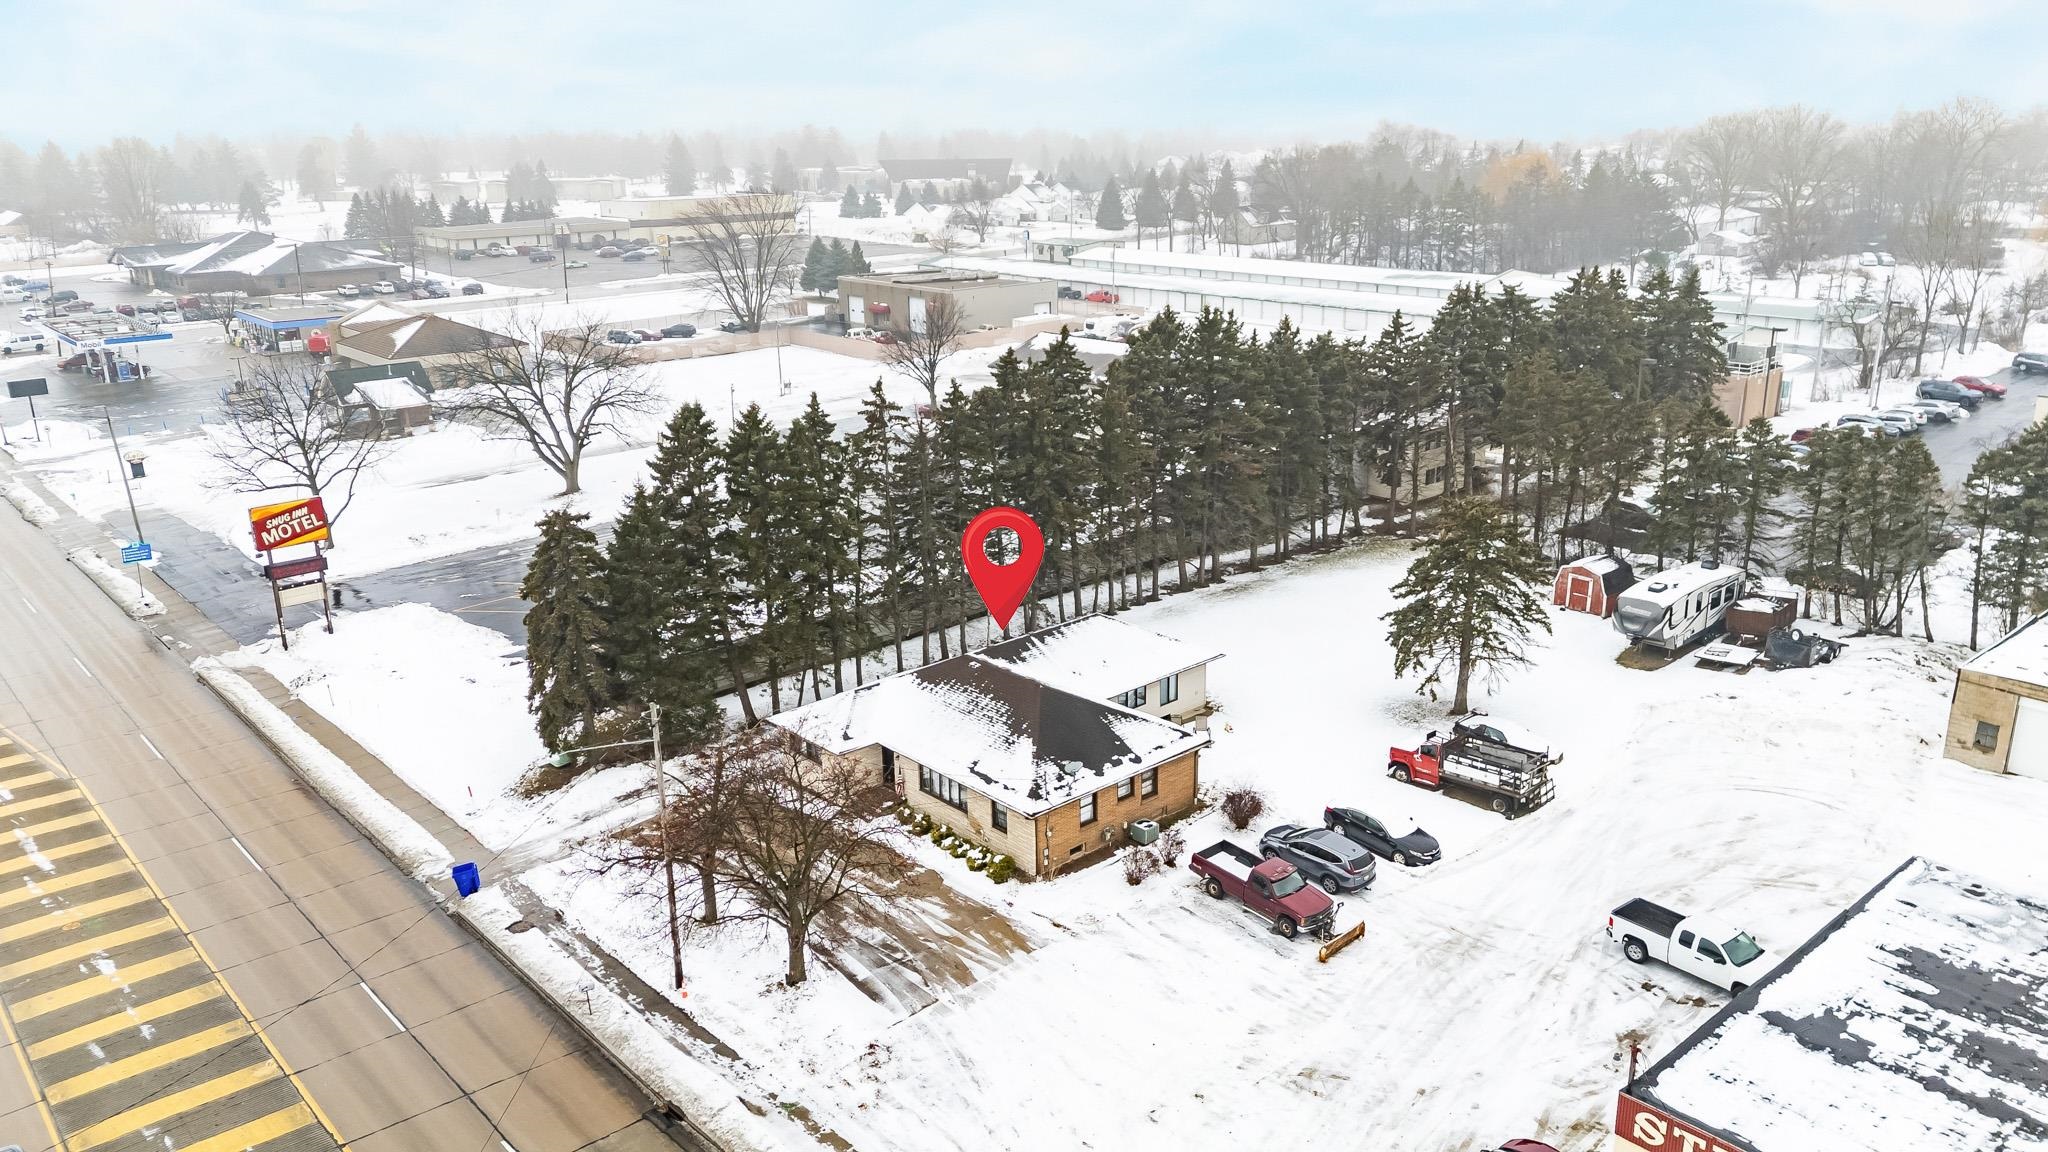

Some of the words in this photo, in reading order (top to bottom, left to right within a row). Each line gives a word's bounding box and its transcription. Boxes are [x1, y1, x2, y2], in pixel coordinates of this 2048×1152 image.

[261, 513, 324, 546] MOTEL
[265, 513, 291, 529] SNUG
[291, 506, 308, 519] INN
[1633, 1112, 1729, 1152] ST
